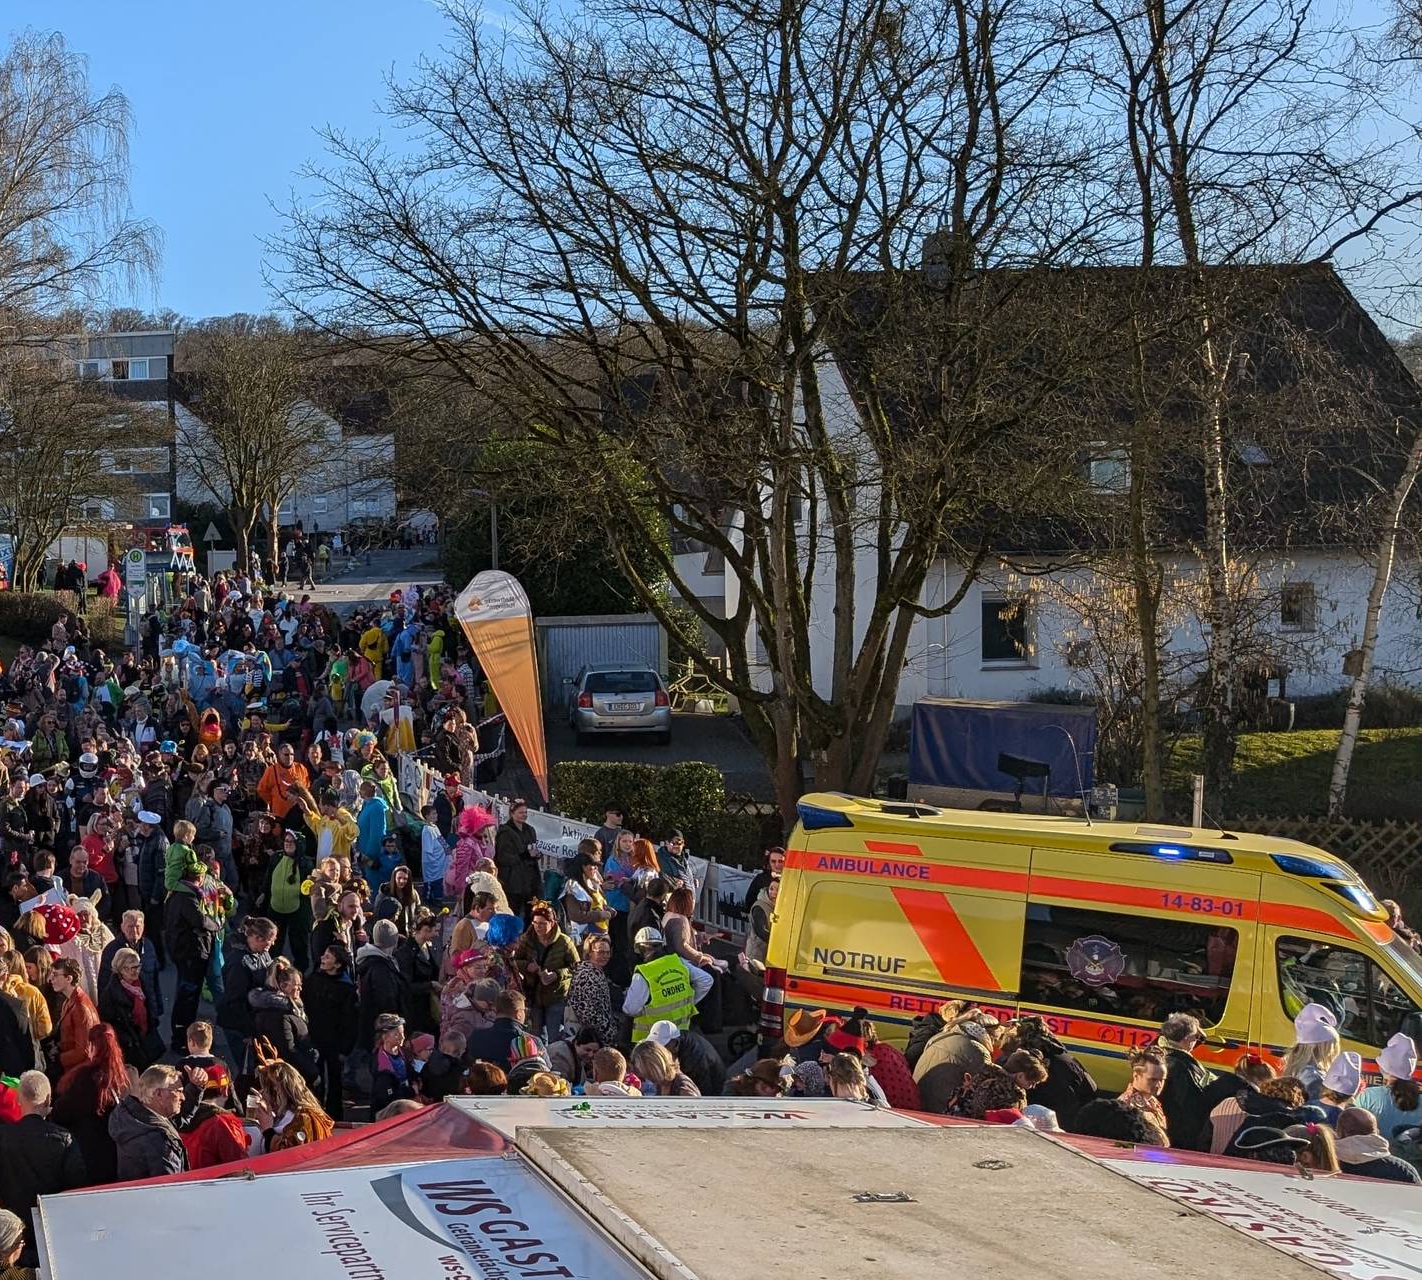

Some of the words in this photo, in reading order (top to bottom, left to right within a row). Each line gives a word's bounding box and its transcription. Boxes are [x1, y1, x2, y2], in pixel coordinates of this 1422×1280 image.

[536, 839, 559, 853] auser
[817, 856, 930, 879] AMBULANCE
[1162, 893, 1243, 916] 14-83-01
[813, 947, 906, 974] NOTRUF
[661, 982, 686, 998] ORDNER
[1117, 1029, 1152, 1047] 112
[300, 1190, 345, 1207] Ihr
[417, 1179, 512, 1216] WS
[1149, 1181, 1355, 1267] GASTRO
